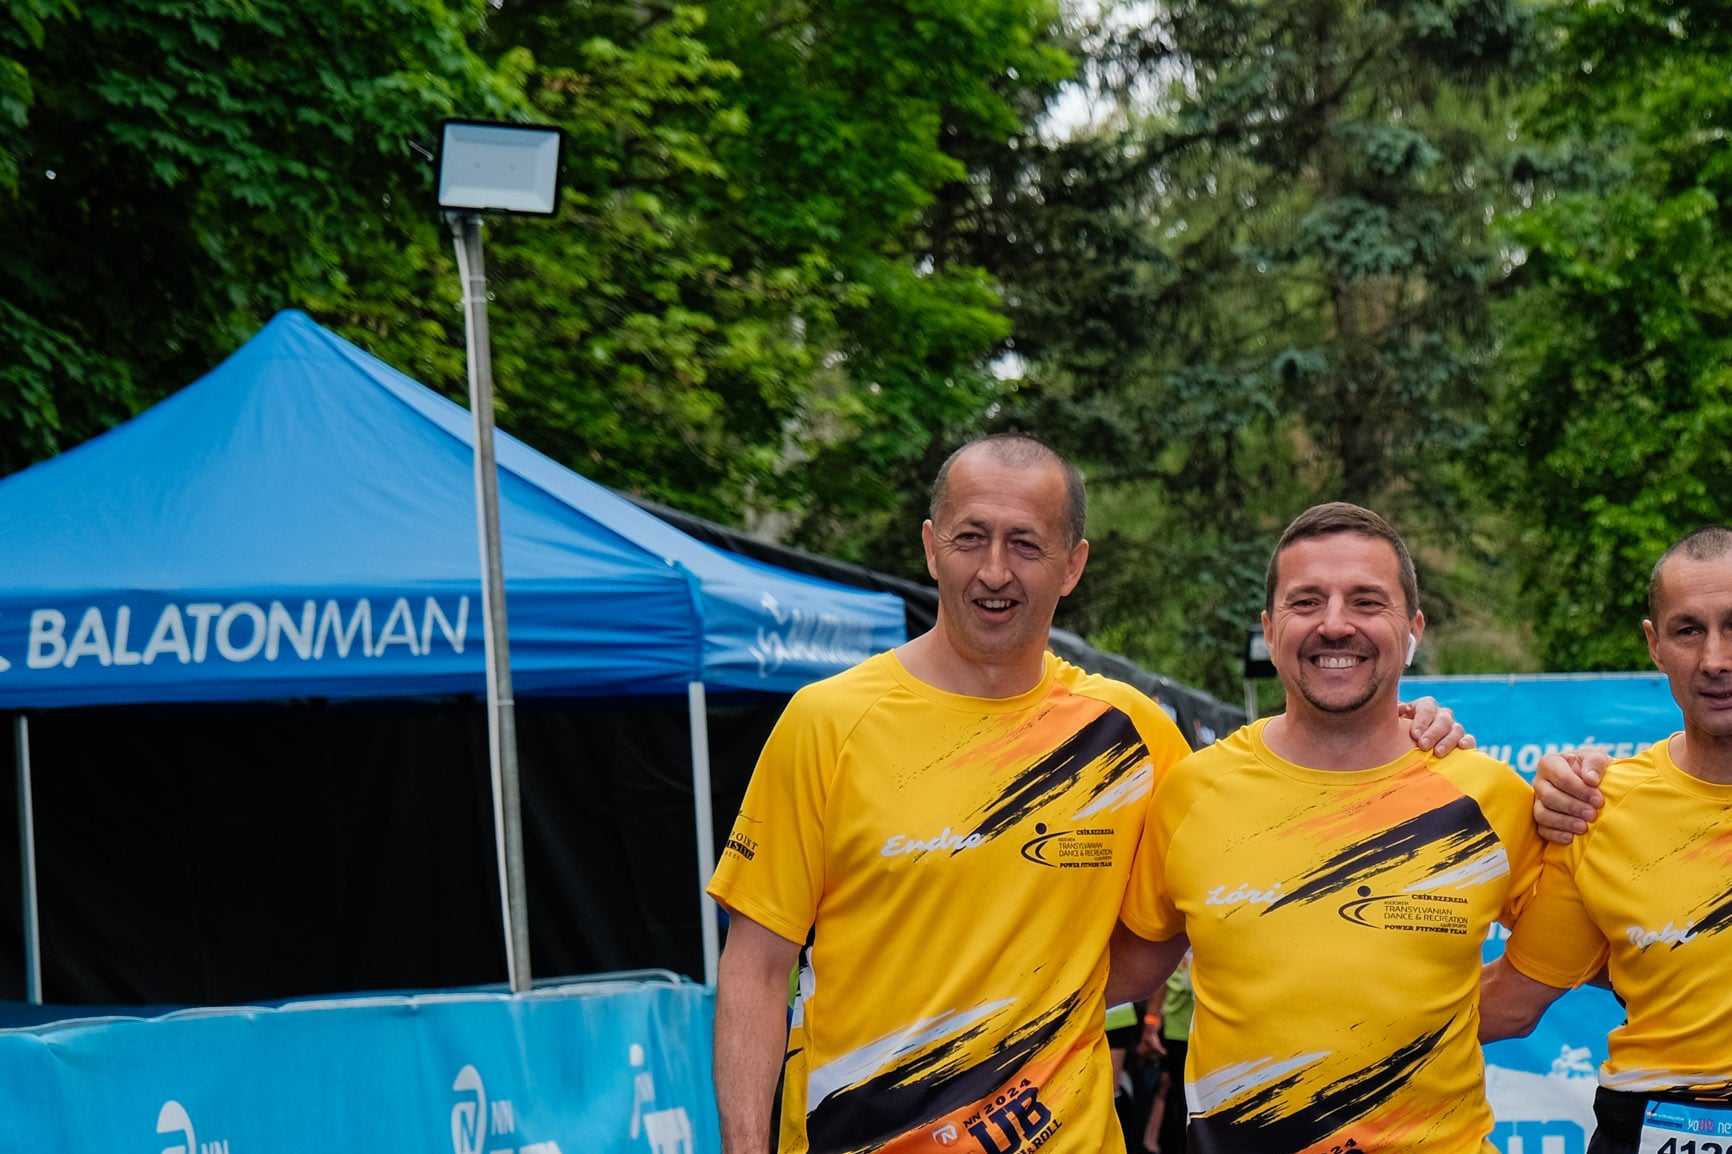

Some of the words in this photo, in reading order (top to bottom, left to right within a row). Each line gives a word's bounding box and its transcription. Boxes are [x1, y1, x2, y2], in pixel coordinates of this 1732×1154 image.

[27, 595, 469, 669] BALATONMAN
[880, 827, 985, 857] Endre
[1384, 905, 1452, 915] TRANSYLVANIAN
[1384, 912, 1414, 920] DANCE
[1415, 913, 1422, 921] &
[1424, 914, 1469, 924] RECREATION
[491, 1100, 515, 1135] NN
[963, 1112, 981, 1128] NN
[983, 1078, 1031, 1115] 2024
